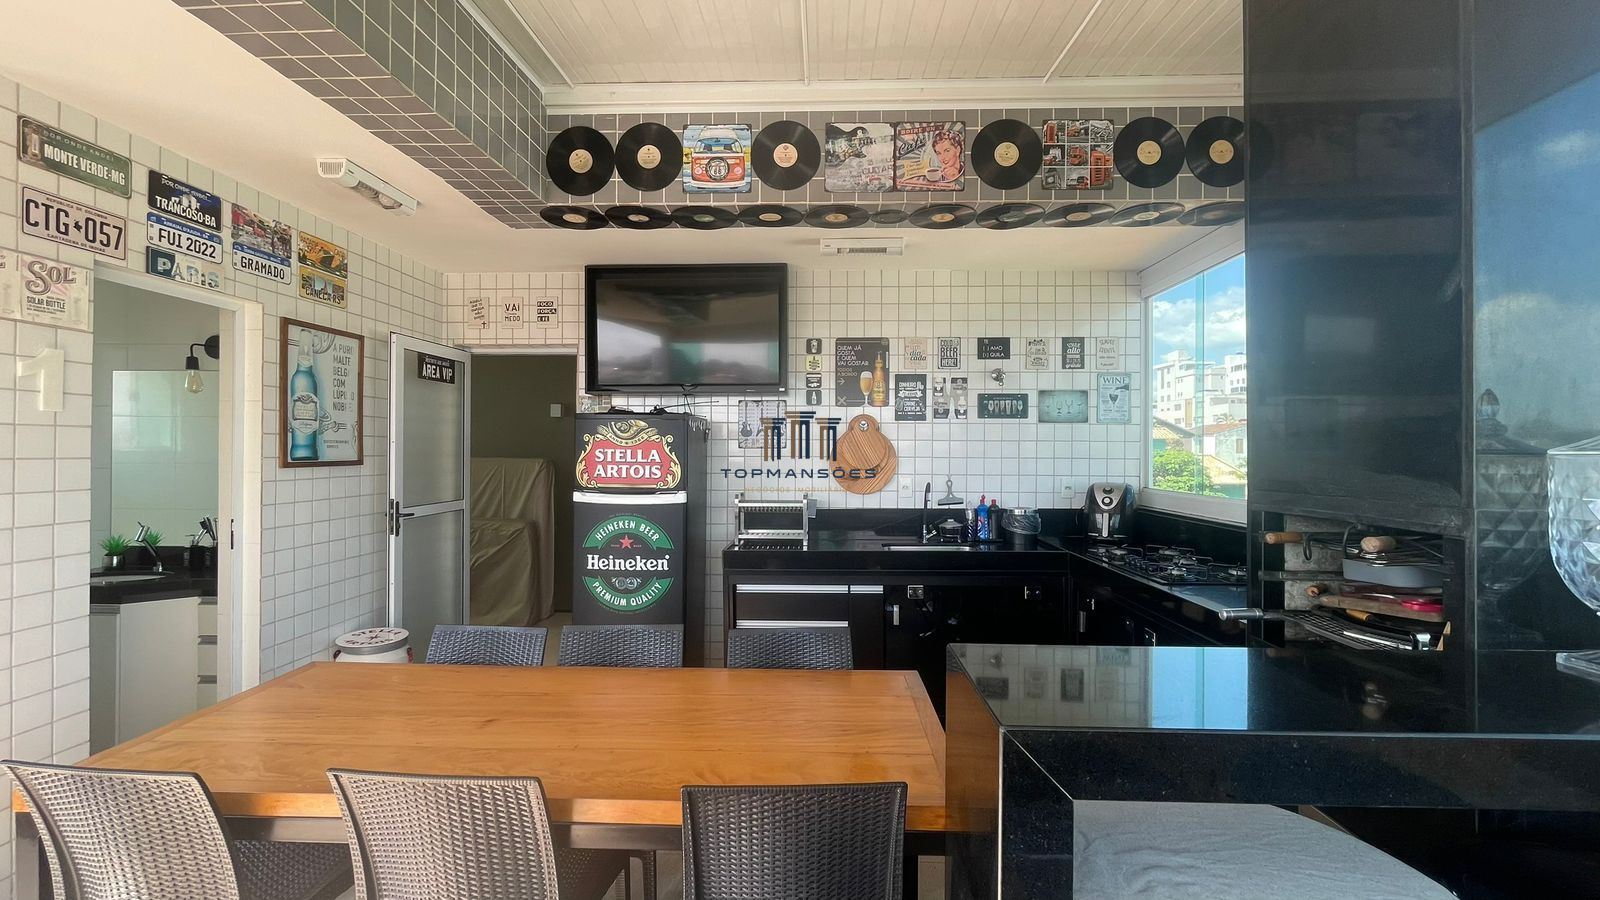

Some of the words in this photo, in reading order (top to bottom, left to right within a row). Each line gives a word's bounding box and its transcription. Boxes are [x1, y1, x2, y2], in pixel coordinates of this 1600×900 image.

[44, 143, 78, 169] MONTE
[80, 156, 125, 186] VERDE-MG
[155, 195, 217, 228] TRANCOSO-BA
[25, 198, 70, 236] CTG
[84, 216, 123, 250] 057
[158, 228, 183, 249] FUI
[186, 237, 216, 259] 2022
[157, 256, 219, 289] PARIS
[240, 255, 285, 280] GRAMADO
[26, 295, 45, 306] SOLAR
[45, 299, 66, 310] BOTTLE
[940, 347, 958, 357] BEER
[332, 366, 348, 378] BELG
[422, 361, 440, 379] ÁREA
[442, 367, 453, 380] VIP
[332, 378, 346, 388] COM
[609, 435, 624, 444] ANNO
[594, 448, 662, 463] STELLA
[594, 464, 662, 479] ARTOIS
[595, 520, 636, 541] HEINEKEN
[639, 523, 660, 541] BEER
[586, 554, 670, 571] Heineken
[592, 581, 627, 606] PREMIUM
[630, 582, 662, 606] QUALITY
